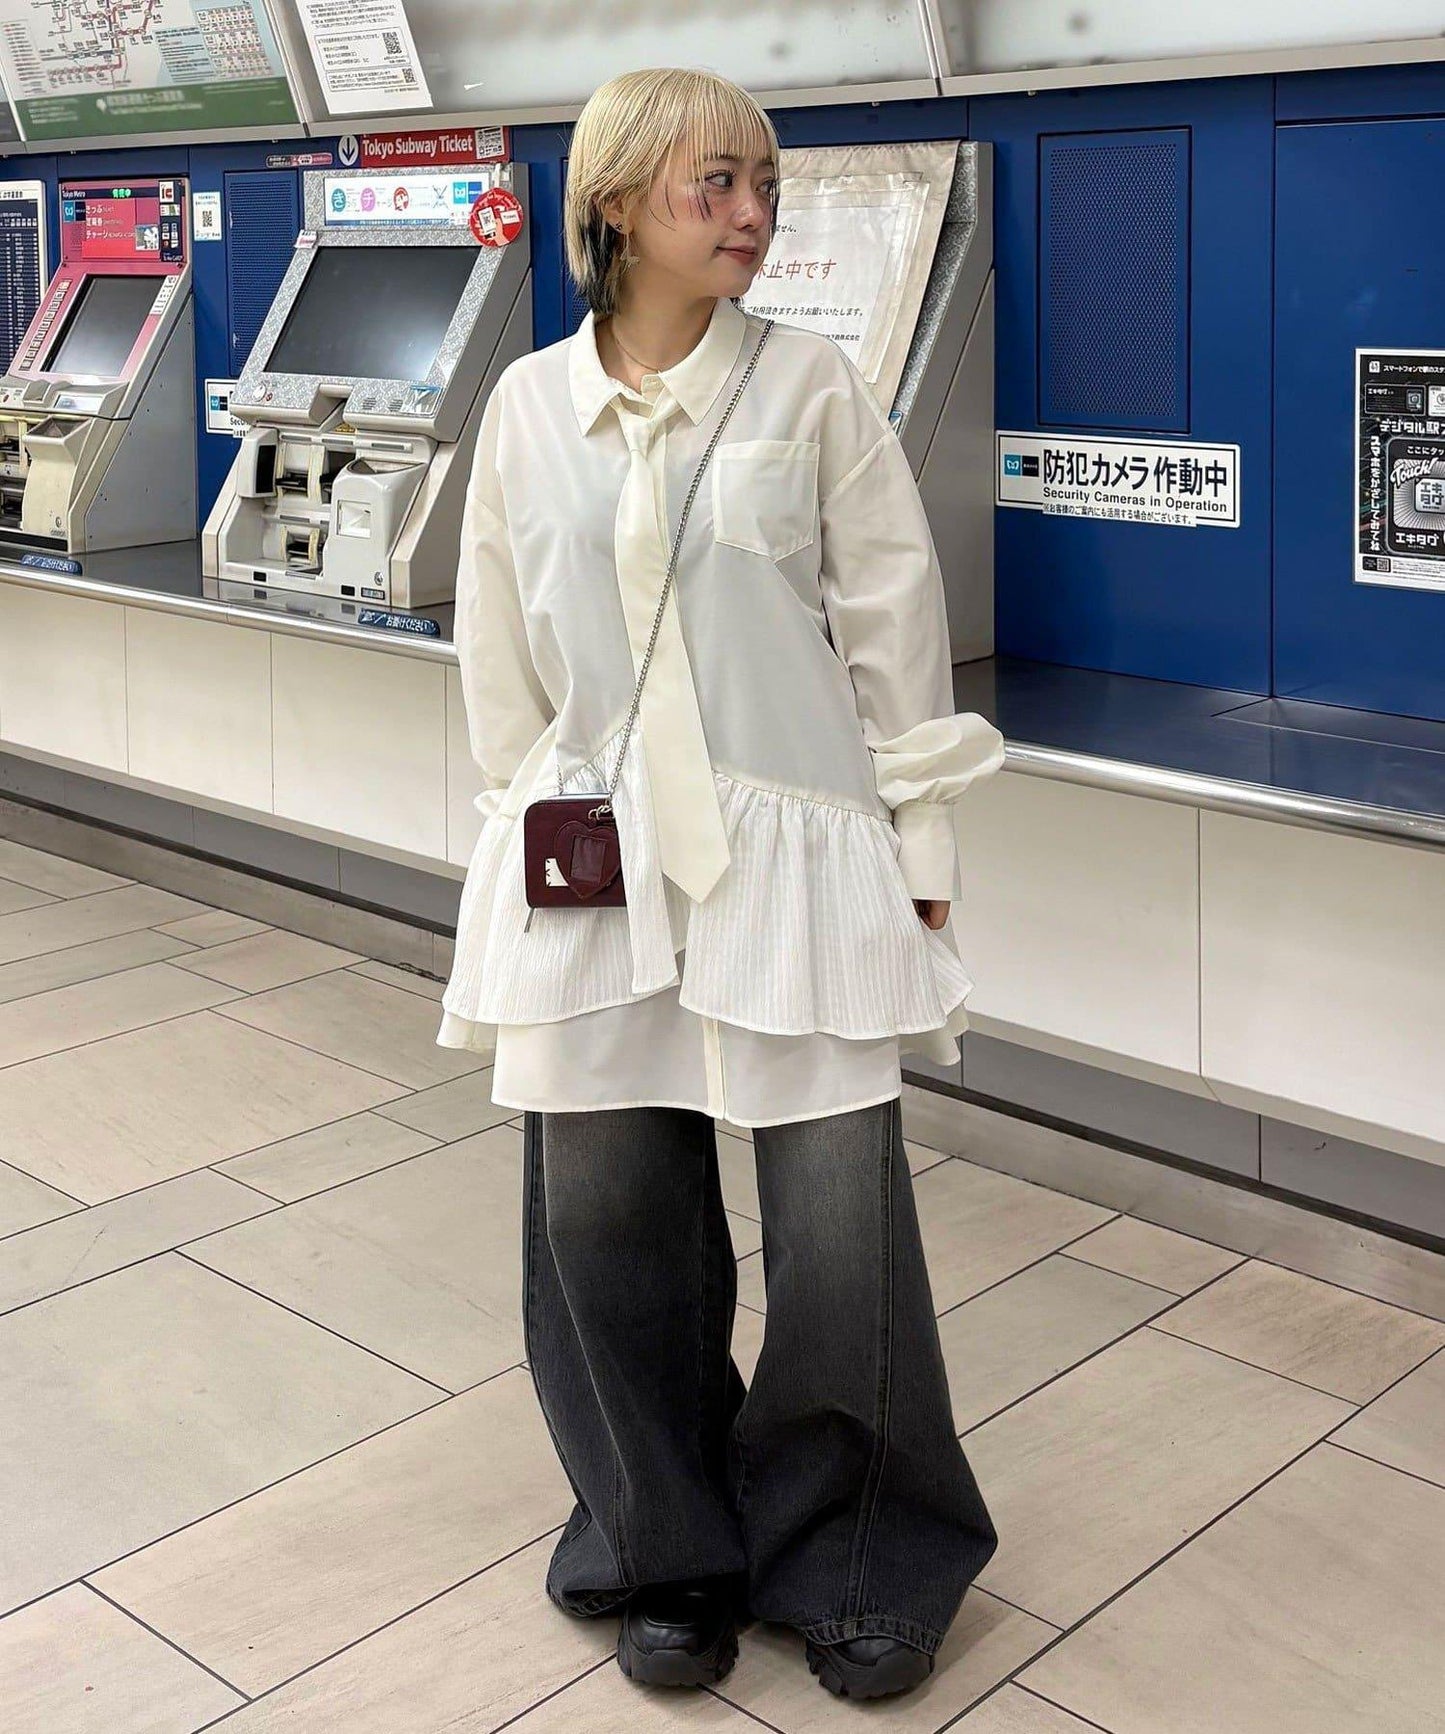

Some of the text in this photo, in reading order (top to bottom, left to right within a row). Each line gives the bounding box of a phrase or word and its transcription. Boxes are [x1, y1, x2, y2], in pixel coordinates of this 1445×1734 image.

[362, 138, 395, 160] Tokyo
[395, 137, 437, 159] Subway
[439, 135, 473, 152] Ticket
[1043, 449, 1228, 498] 防犯カメラ作動中
[1390, 457, 1439, 489] Touch!
[1421, 481, 1443, 493] エキ
[1421, 493, 1444, 506] タグ
[1043, 487, 1228, 513] Security Cameras in Operation
[1395, 532, 1440, 547] エキタグ
